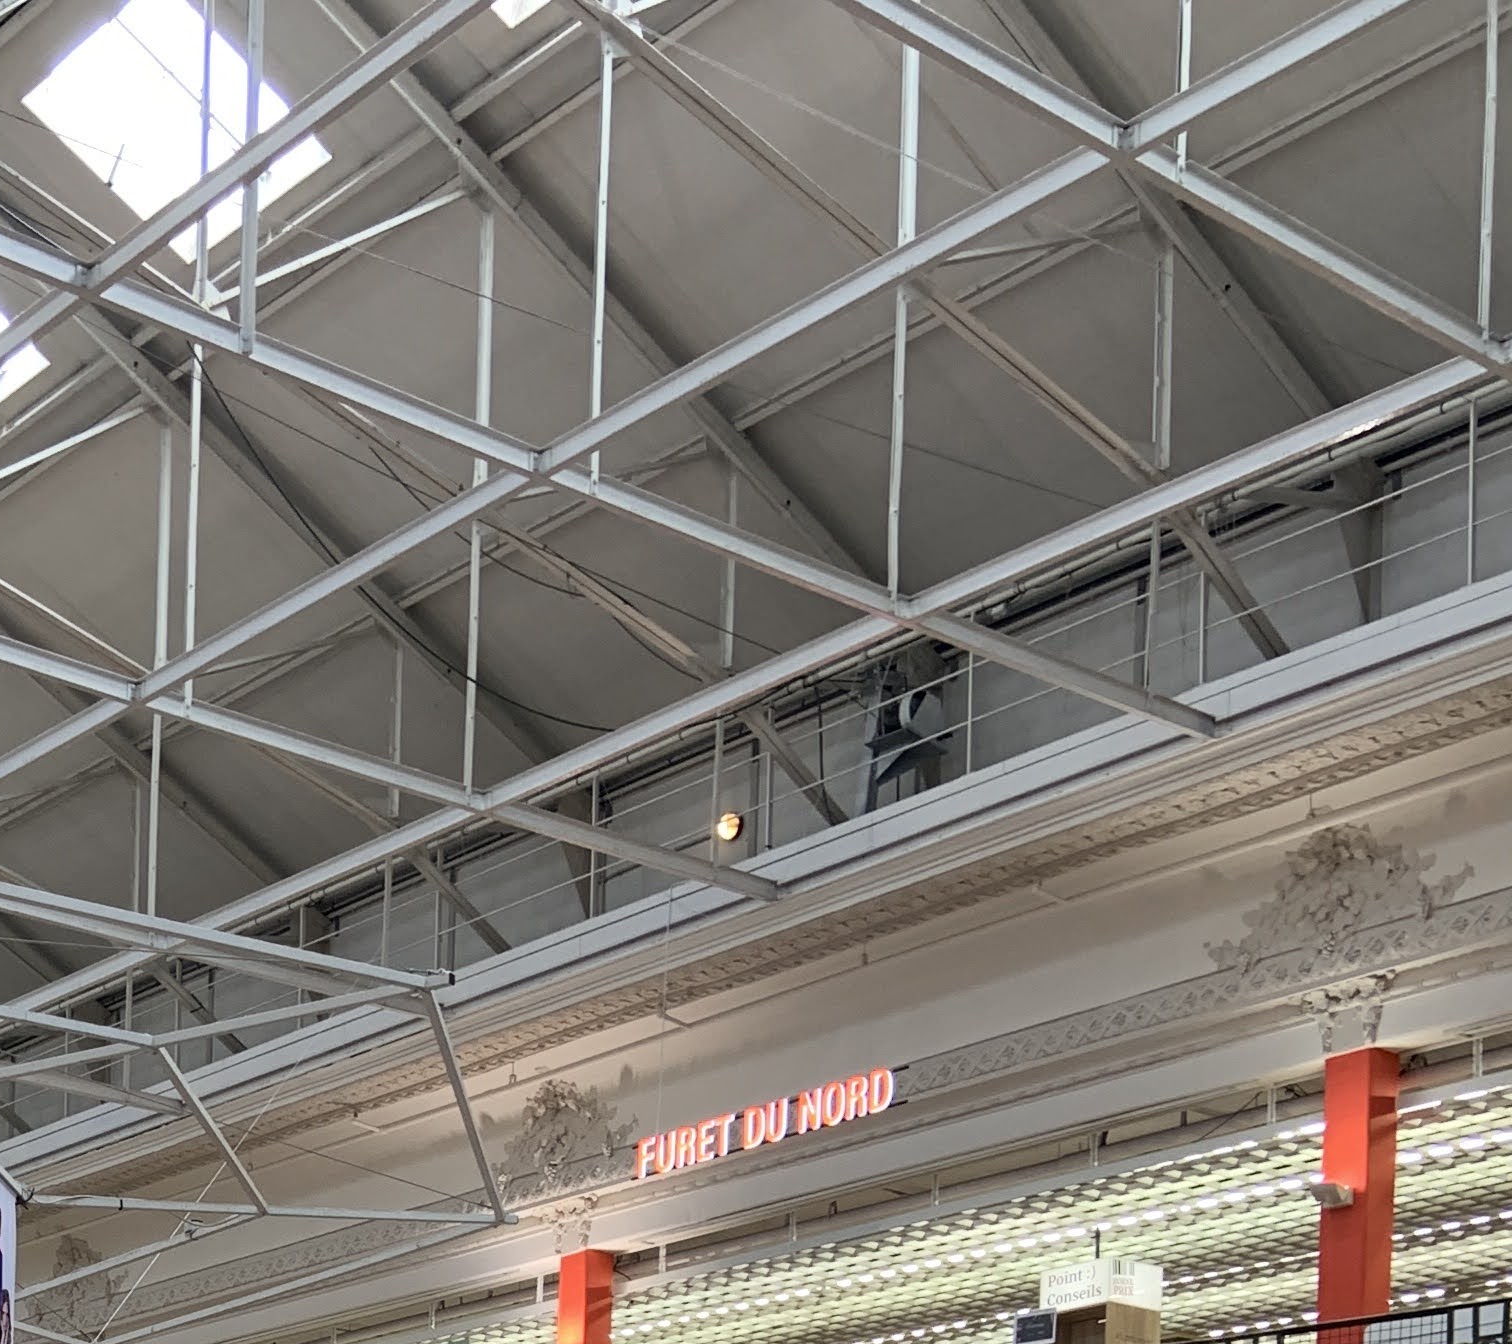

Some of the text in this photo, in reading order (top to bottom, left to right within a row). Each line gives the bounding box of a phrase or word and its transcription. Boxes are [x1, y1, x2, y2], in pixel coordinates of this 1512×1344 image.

[636, 1067, 894, 1179] FURET DU NORD
[1048, 1270, 1082, 1288] Point
[1047, 1284, 1102, 1307] Conseils
